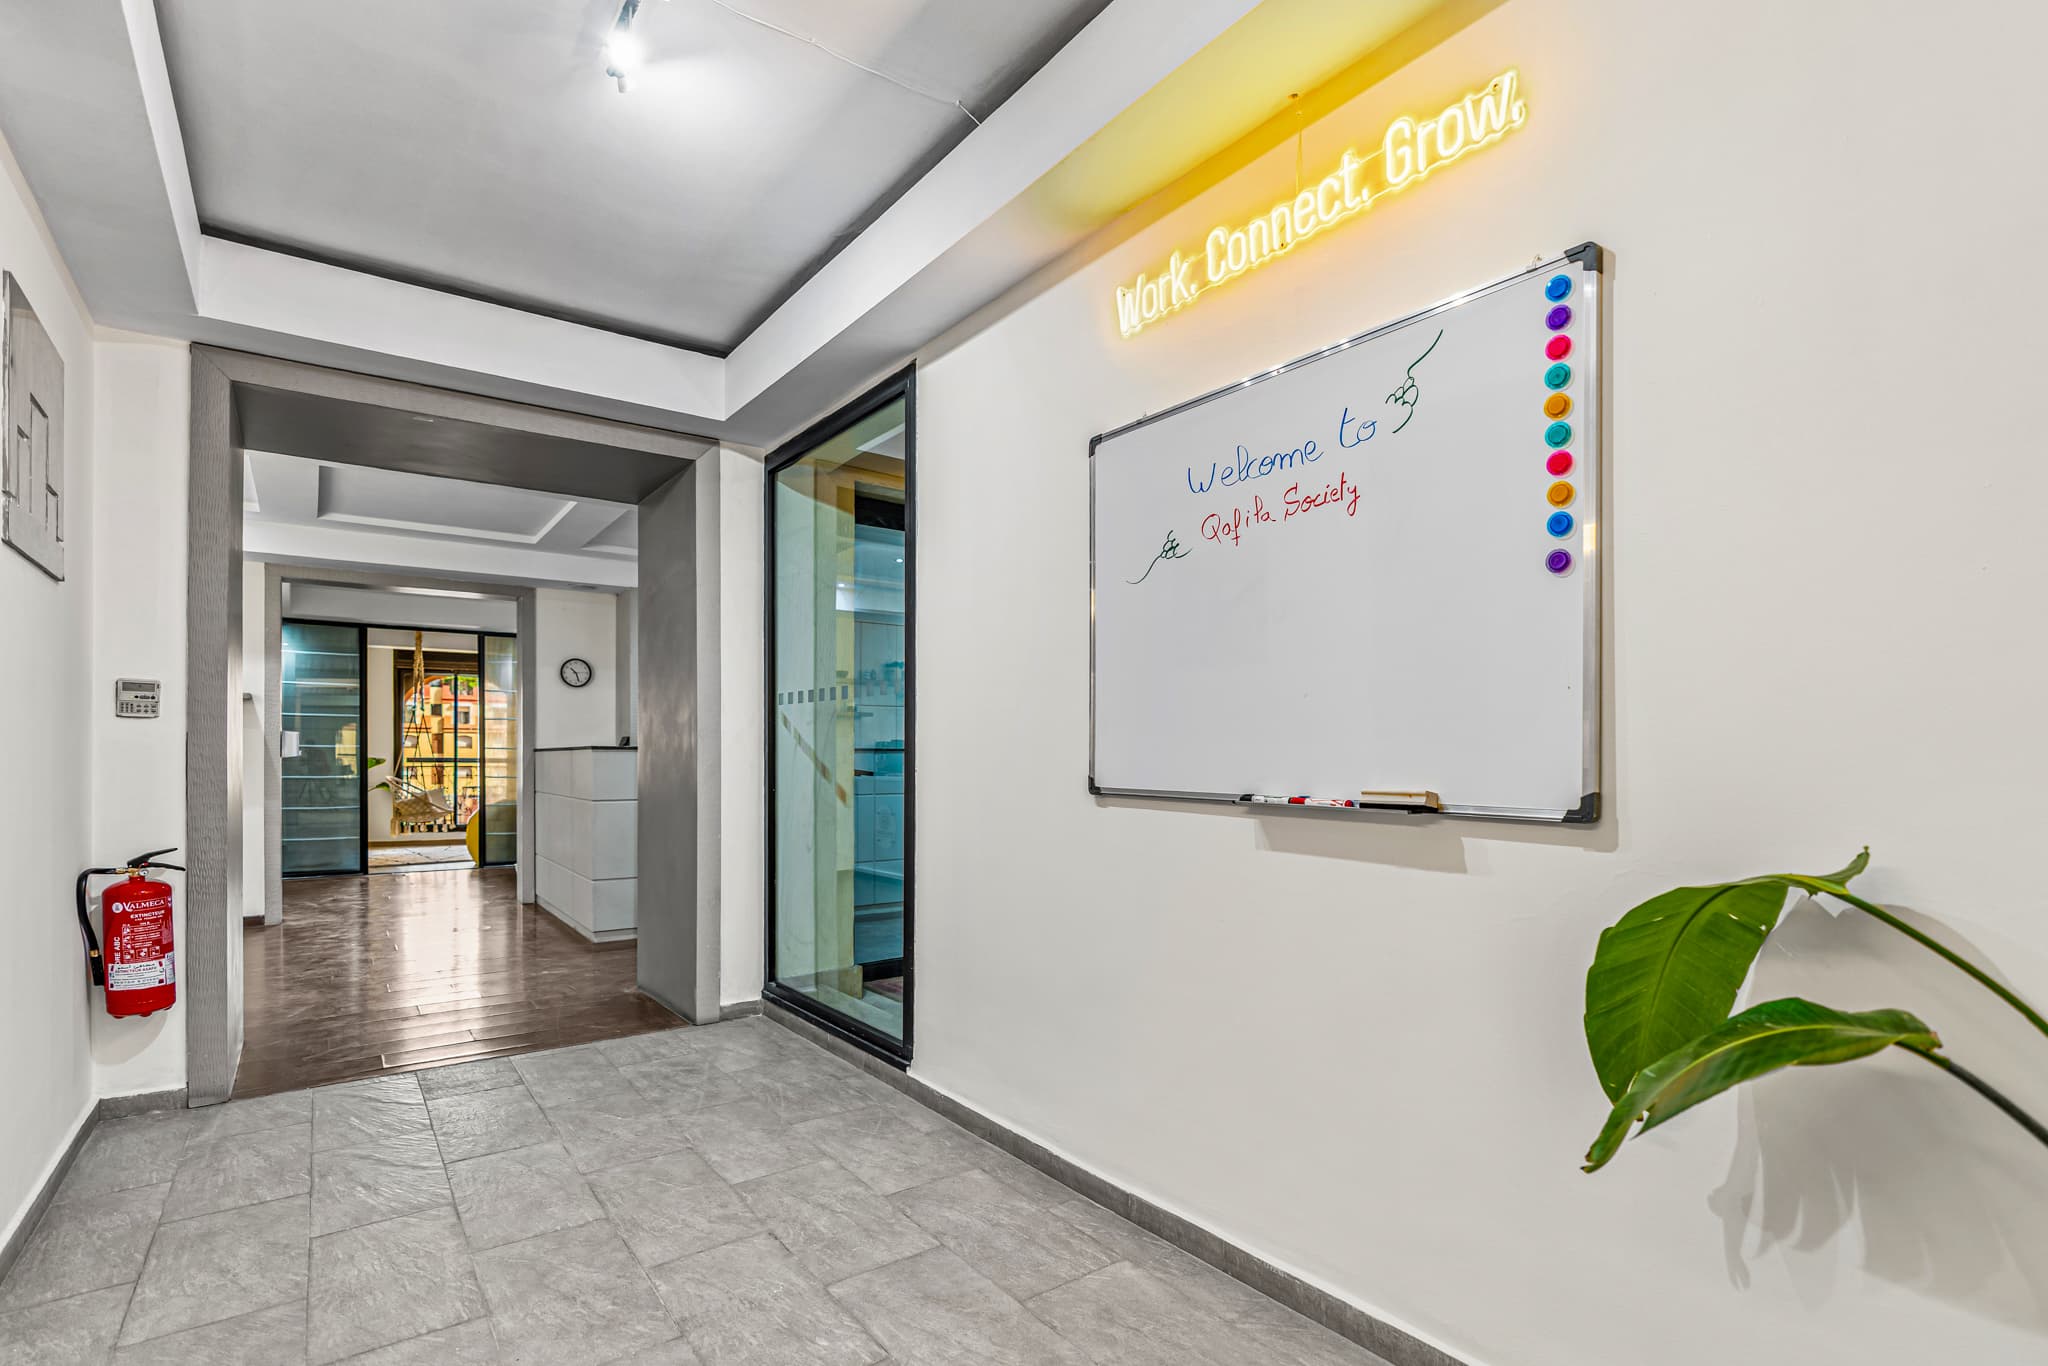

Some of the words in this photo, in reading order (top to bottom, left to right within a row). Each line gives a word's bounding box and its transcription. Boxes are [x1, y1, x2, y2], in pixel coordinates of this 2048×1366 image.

[1117, 252, 1198, 334] Work.
[1206, 153, 1368, 282] Connect.
[1385, 72, 1523, 184] Grow.
[1187, 439, 1325, 495] Welcome
[1338, 407, 1378, 449] to
[1283, 471, 1361, 518] Society
